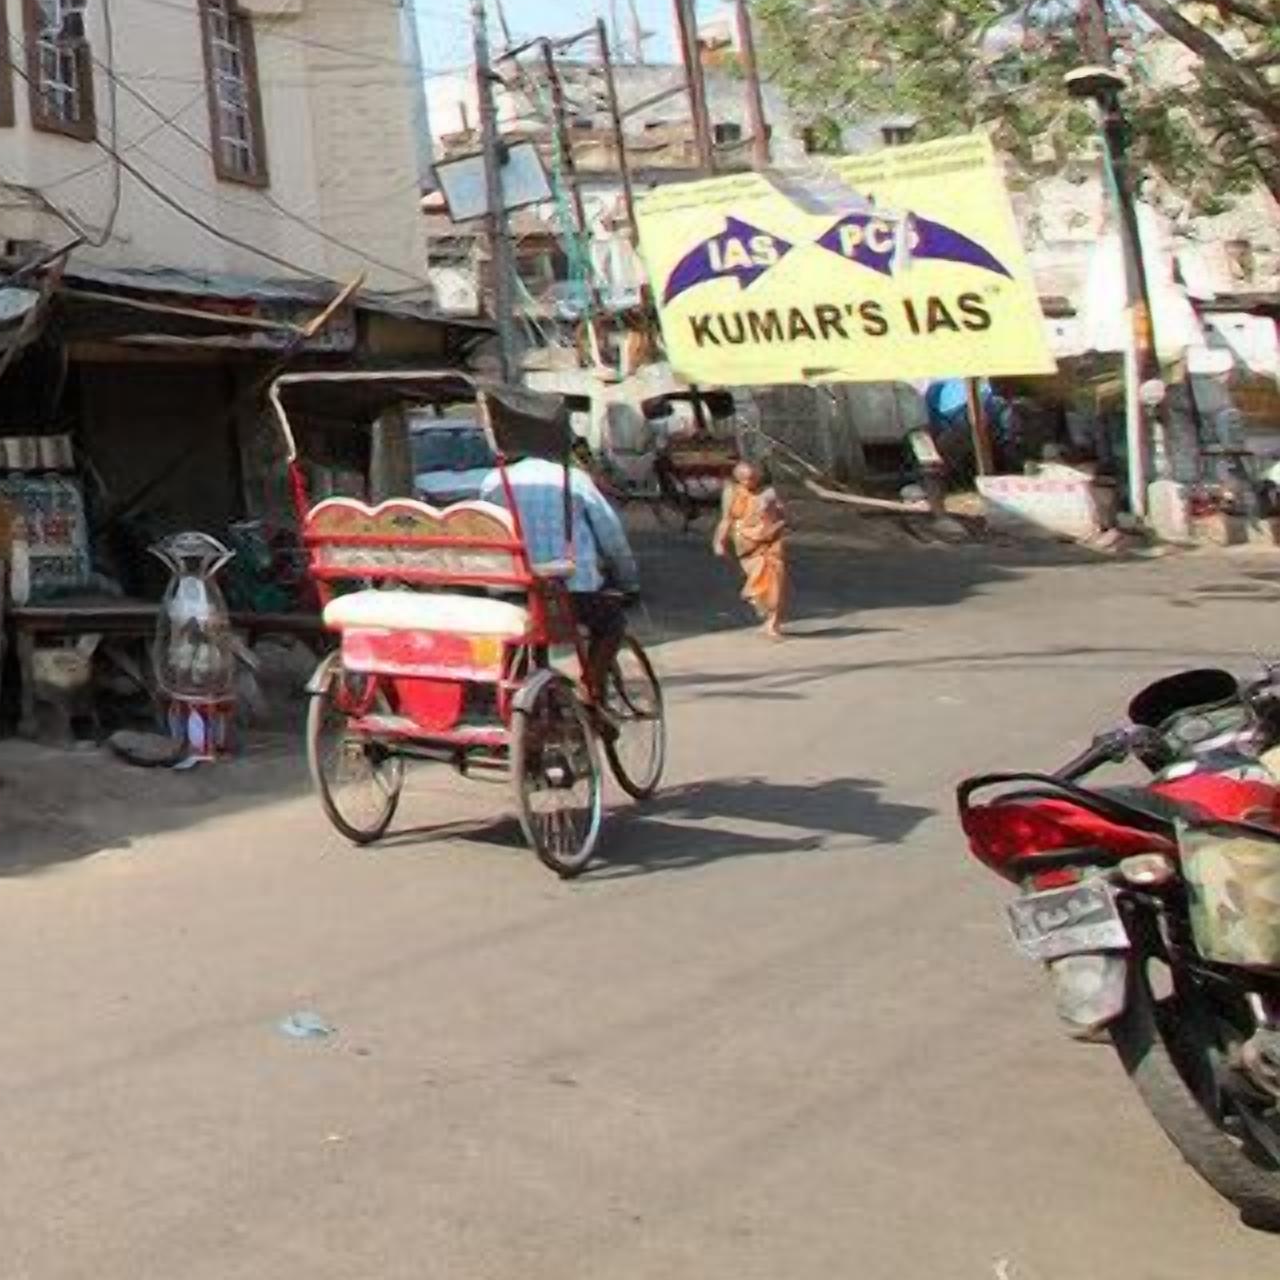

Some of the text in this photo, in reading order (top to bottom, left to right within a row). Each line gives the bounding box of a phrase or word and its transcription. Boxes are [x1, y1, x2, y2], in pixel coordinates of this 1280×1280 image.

[706, 235, 779, 273] IAS
[688, 291, 993, 348] KUMAR'S IAS
